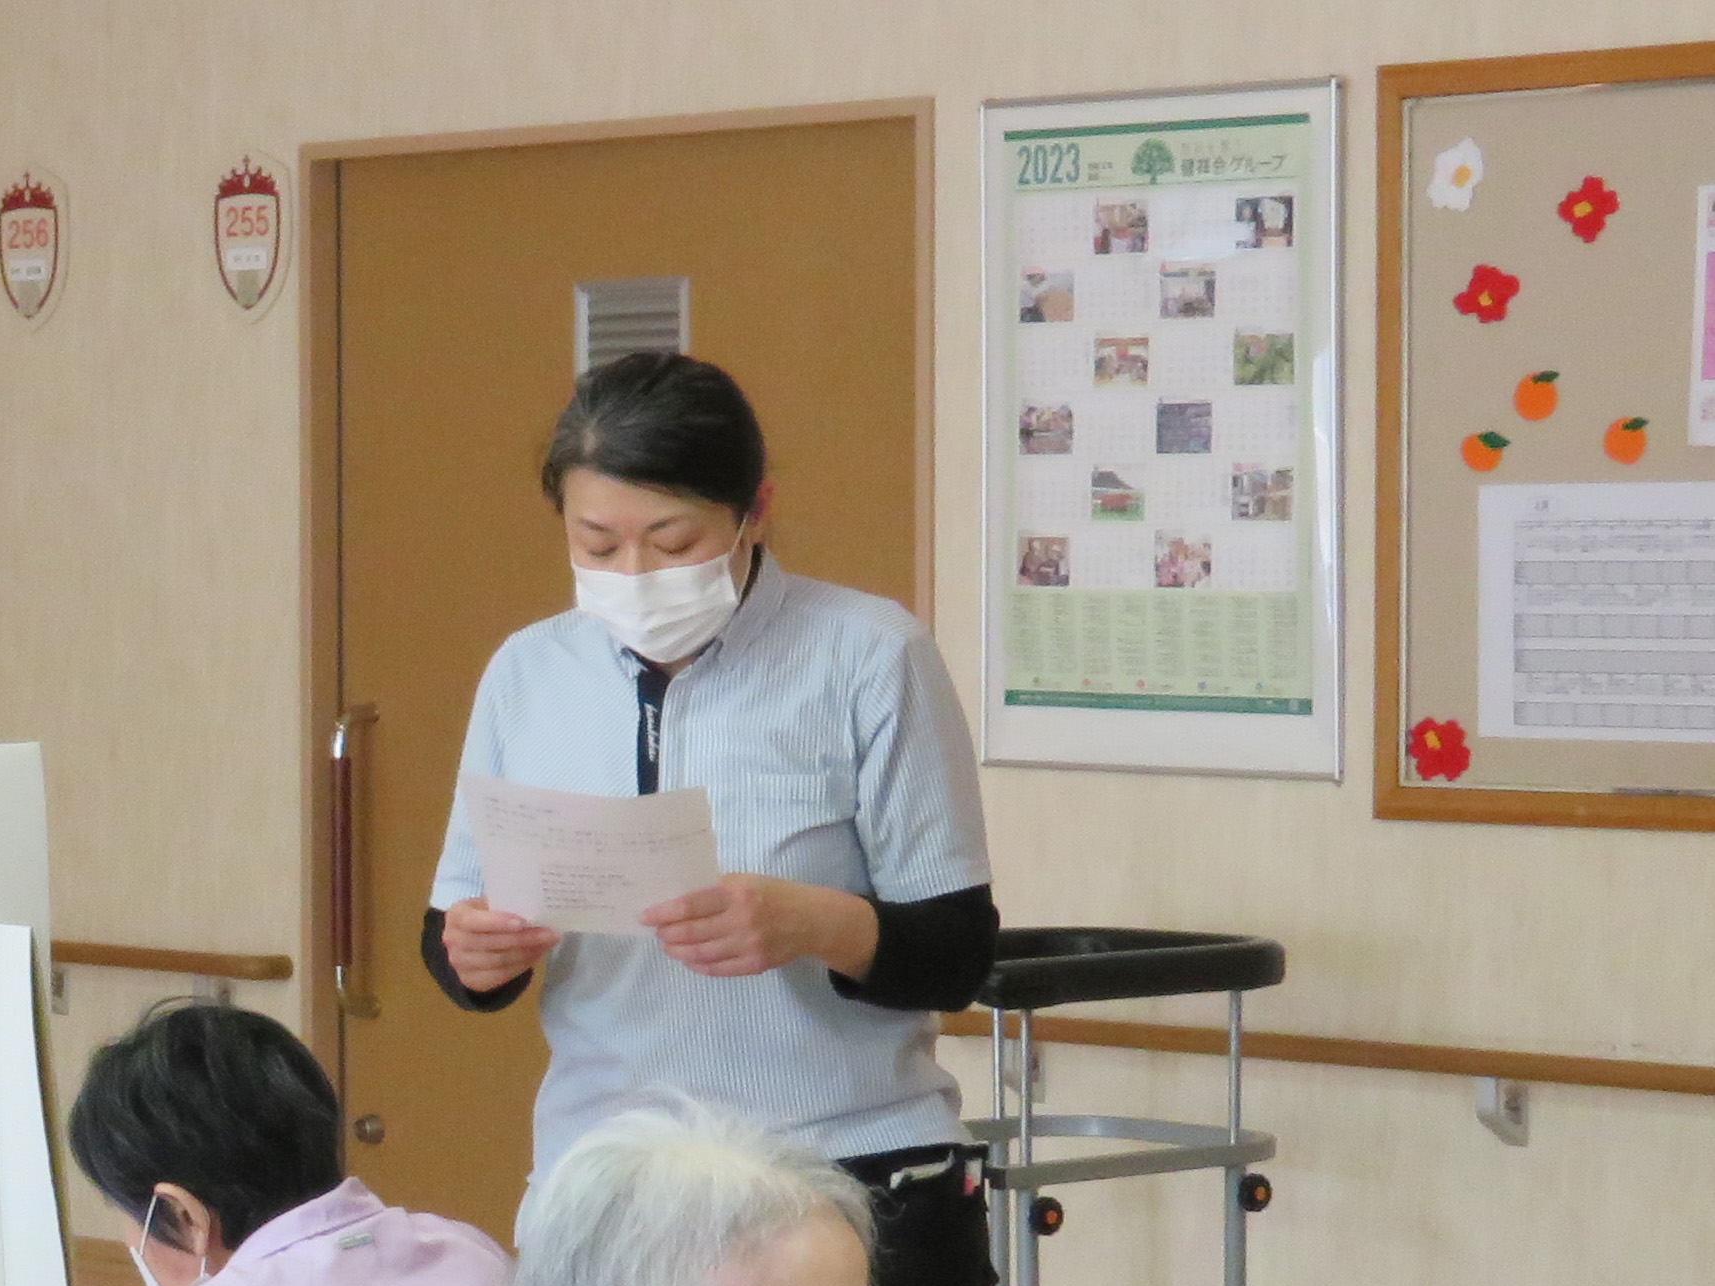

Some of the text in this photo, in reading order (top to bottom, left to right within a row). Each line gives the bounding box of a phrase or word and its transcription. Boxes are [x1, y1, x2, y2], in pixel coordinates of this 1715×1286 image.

[1017, 143, 1080, 184] 2023
[7, 218, 49, 250] 256
[225, 205, 270, 238] 255
